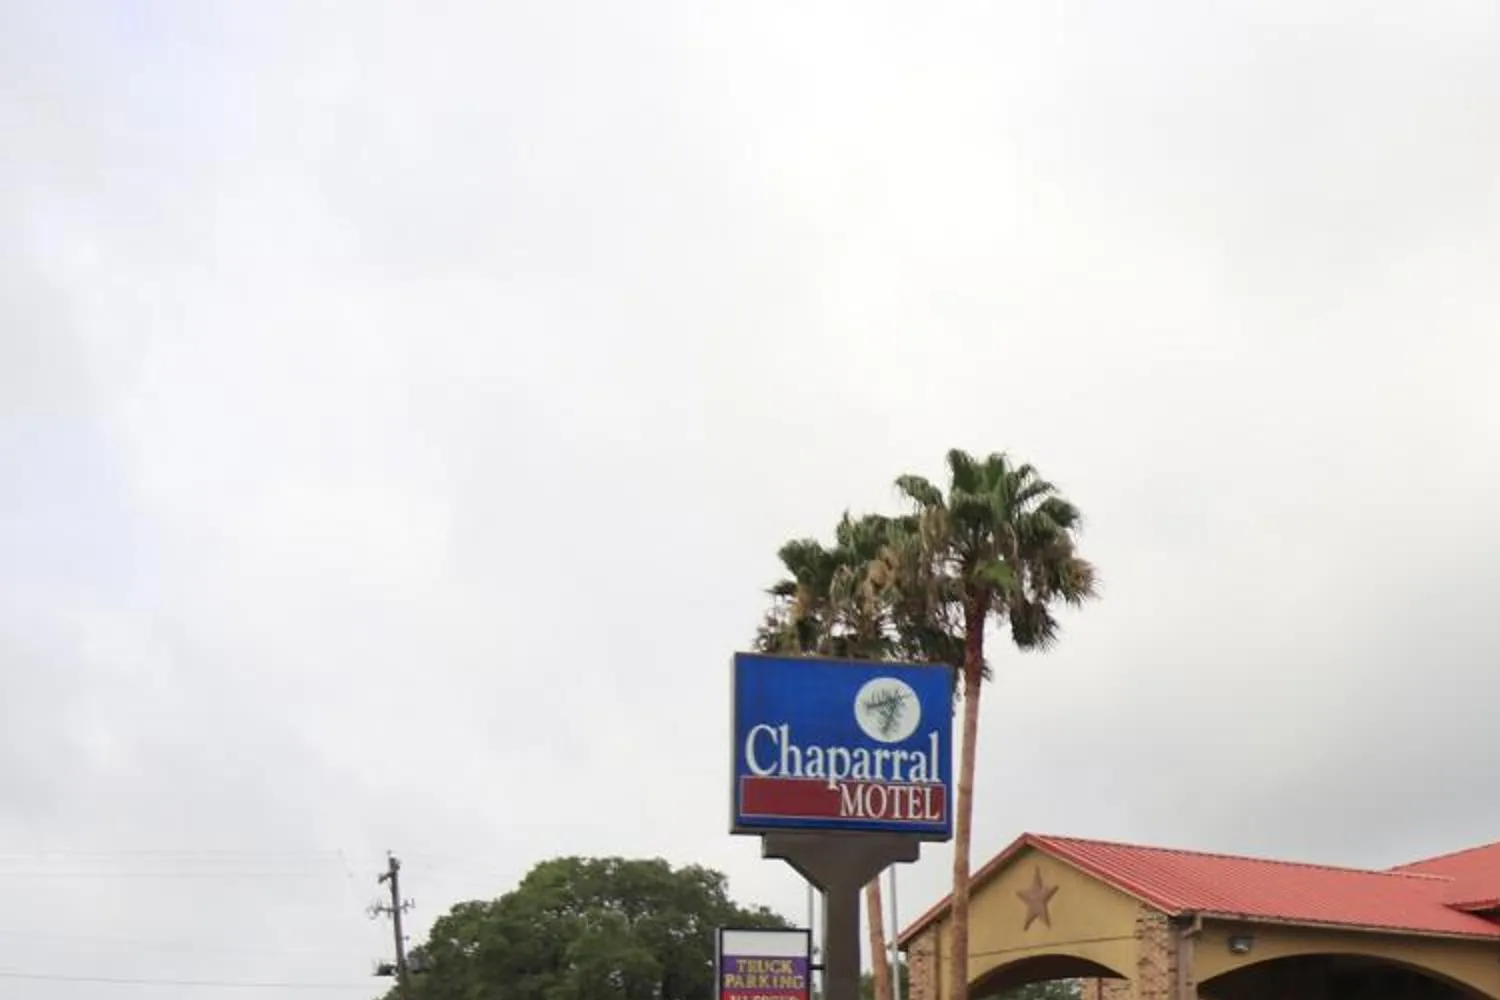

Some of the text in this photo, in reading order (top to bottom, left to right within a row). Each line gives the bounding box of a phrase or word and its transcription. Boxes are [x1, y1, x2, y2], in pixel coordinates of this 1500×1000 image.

[745, 723, 941, 789] Chaparral
[839, 783, 939, 820] MOTEL
[736, 959, 793, 973] TRUCK
[724, 973, 805, 988] PARKING
